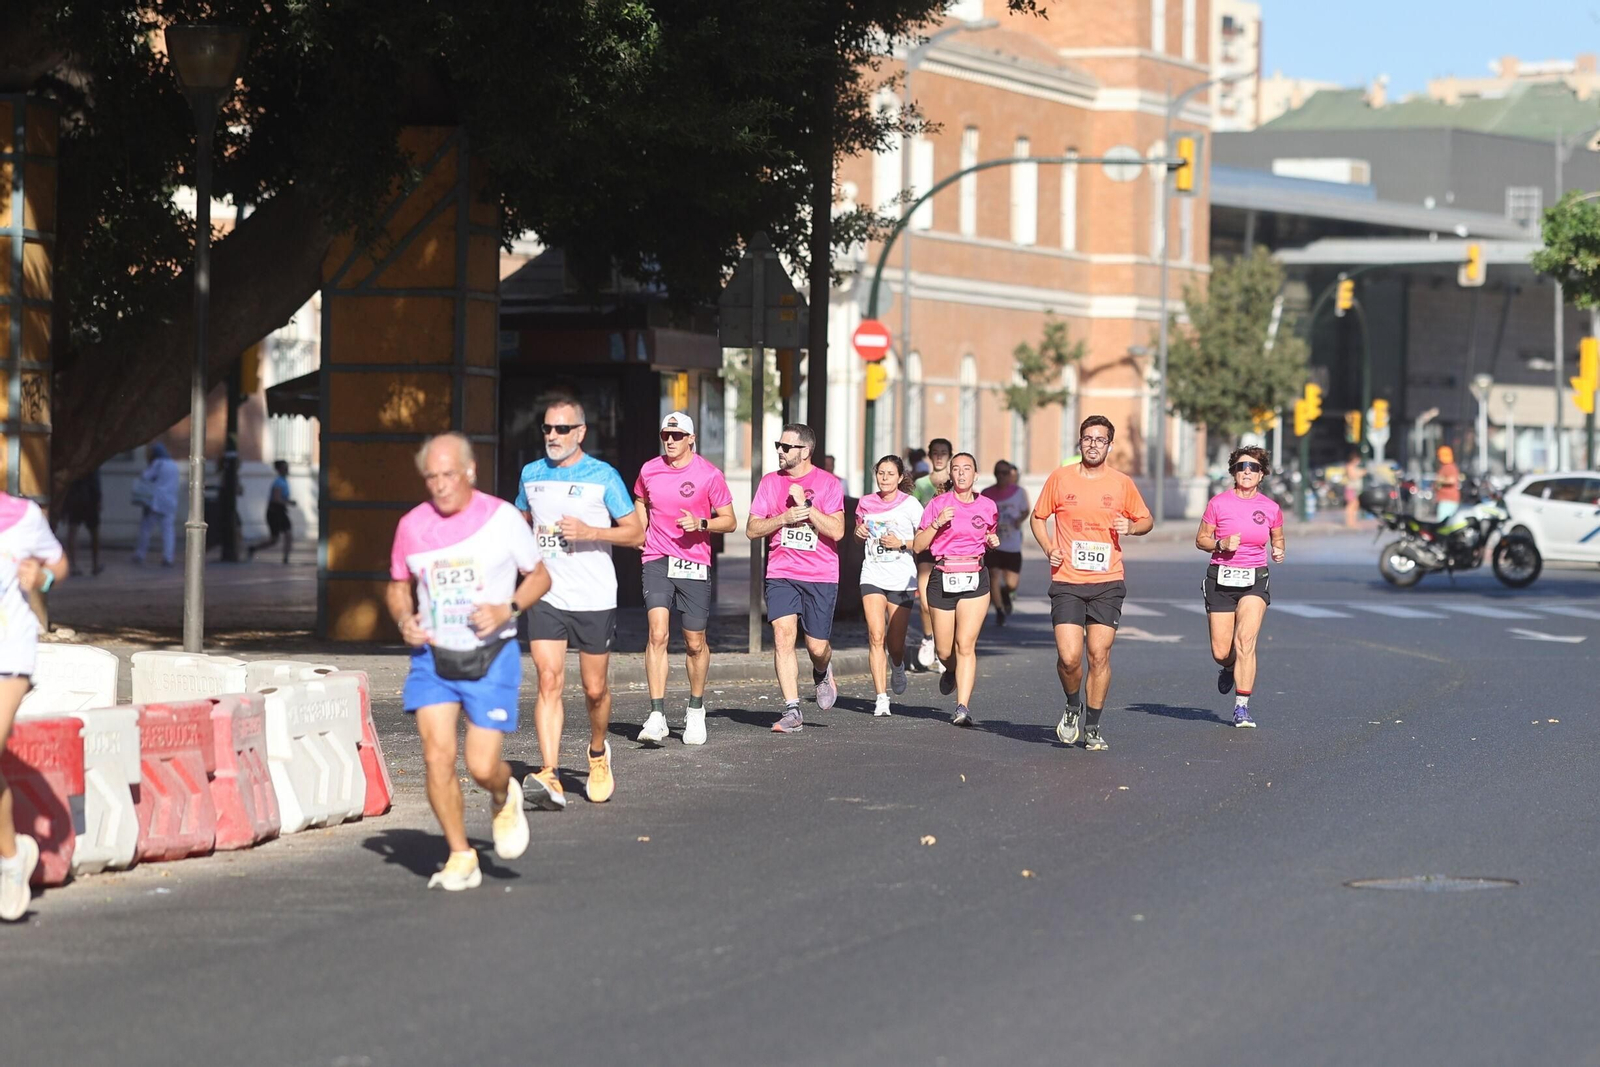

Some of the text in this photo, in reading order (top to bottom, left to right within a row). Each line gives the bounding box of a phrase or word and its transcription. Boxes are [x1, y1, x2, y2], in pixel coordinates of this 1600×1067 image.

[787, 530, 811, 542] 505
[1078, 551, 1105, 563] 350
[436, 568, 475, 585] 523
[1223, 569, 1250, 580] 222
